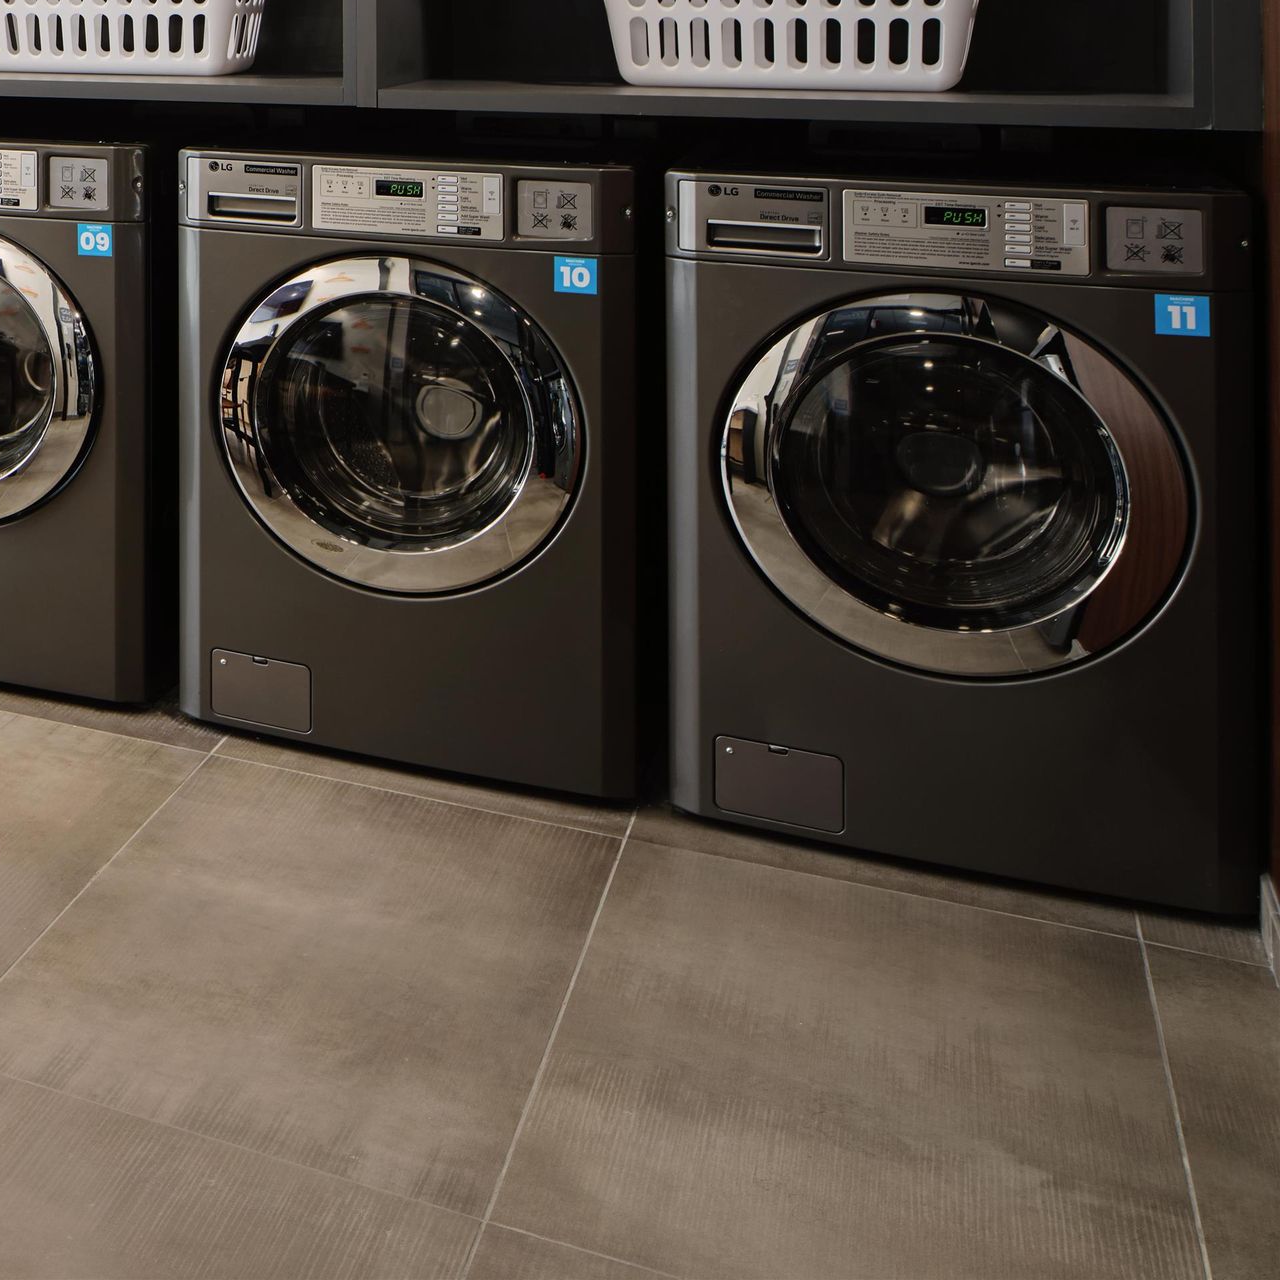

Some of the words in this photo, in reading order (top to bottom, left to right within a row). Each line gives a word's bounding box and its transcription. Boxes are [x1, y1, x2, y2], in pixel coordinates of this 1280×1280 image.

[245, 165, 276, 173] Commercial
[390, 184, 421, 195] PUSH
[756, 190, 795, 199] Commercial
[795, 192, 823, 200] Washer
[759, 213, 780, 221] Direct
[943, 211, 983, 223] PUSH
[80, 231, 110, 252] 09
[560, 266, 591, 288] 10
[1167, 305, 1196, 330] 11
